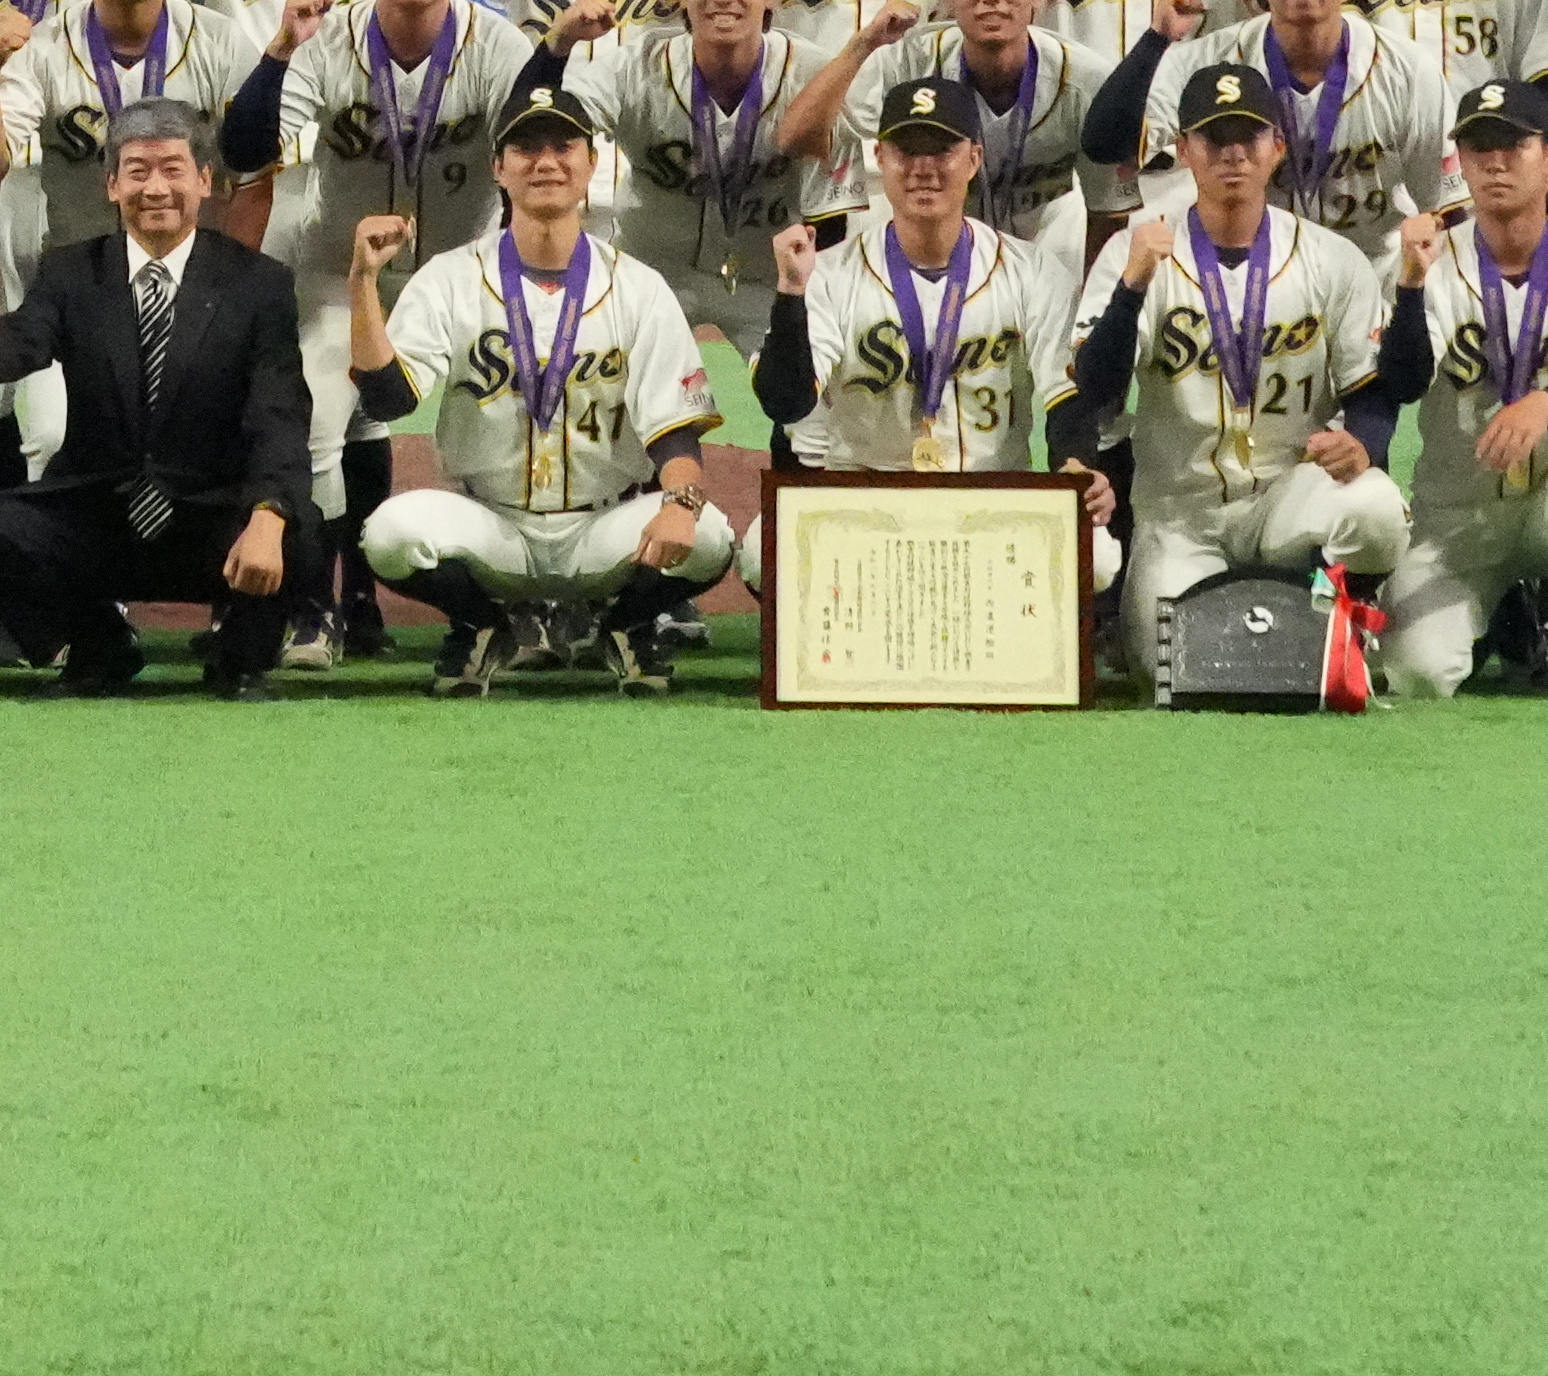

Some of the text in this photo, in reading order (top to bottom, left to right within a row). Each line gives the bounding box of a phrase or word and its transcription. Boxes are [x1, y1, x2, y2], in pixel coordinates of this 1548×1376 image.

[1455, 15, 1498, 57] 58
[1262, 374, 1313, 416] 21
[576, 402, 628, 444] 41
